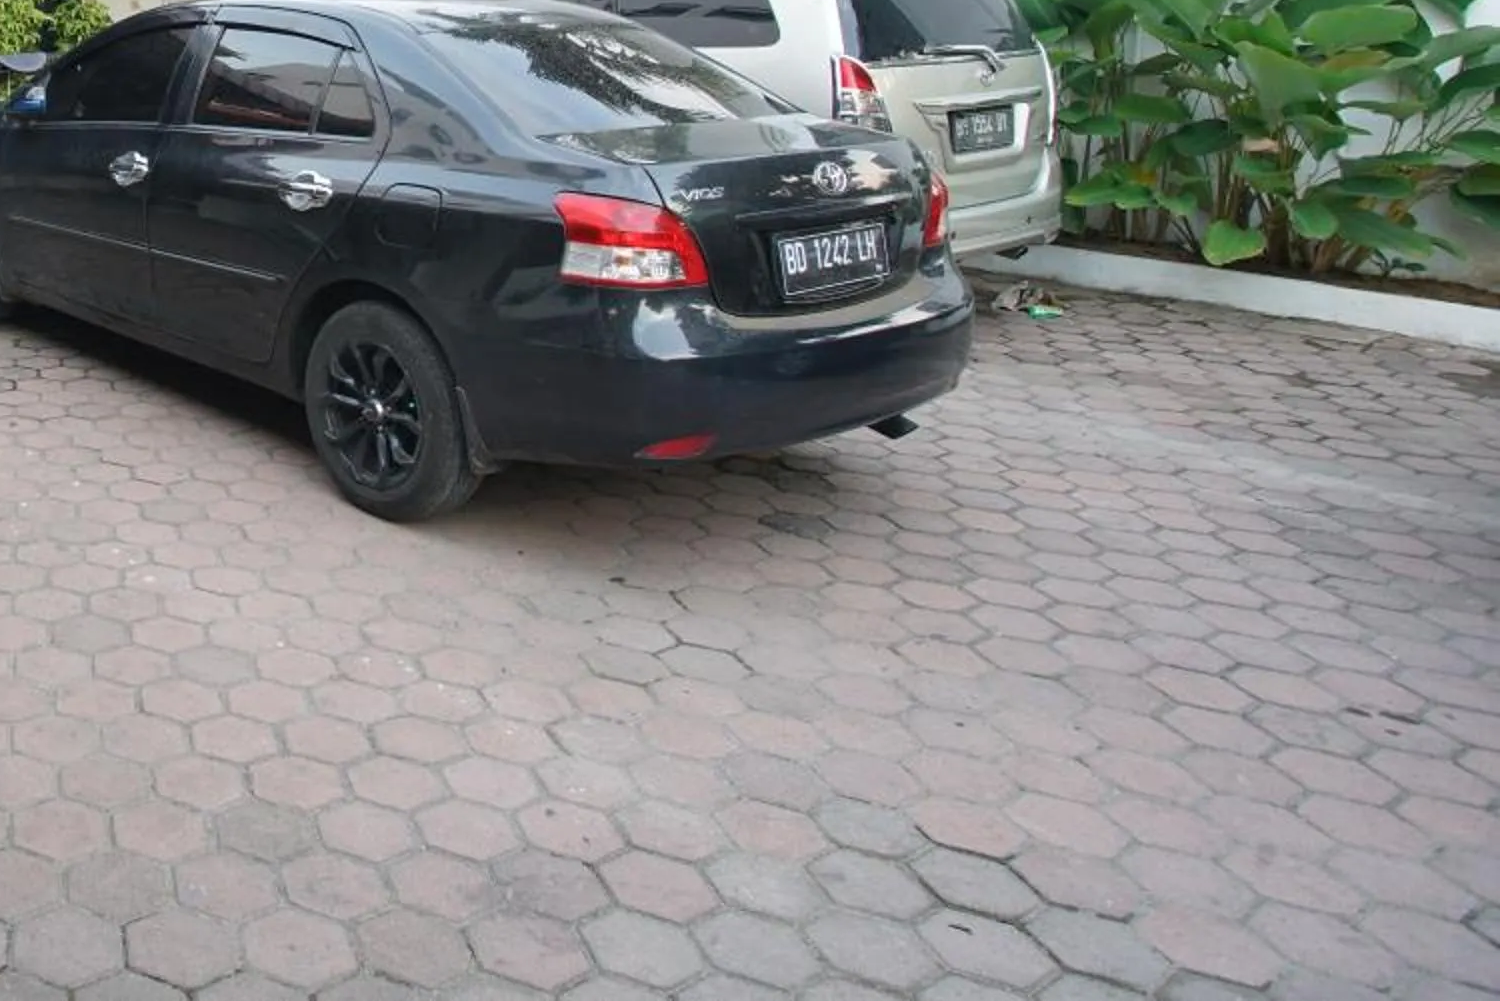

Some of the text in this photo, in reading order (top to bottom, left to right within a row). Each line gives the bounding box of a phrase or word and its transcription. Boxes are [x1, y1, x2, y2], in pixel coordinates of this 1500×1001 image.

[785, 229, 878, 275] BD 1242 LH
